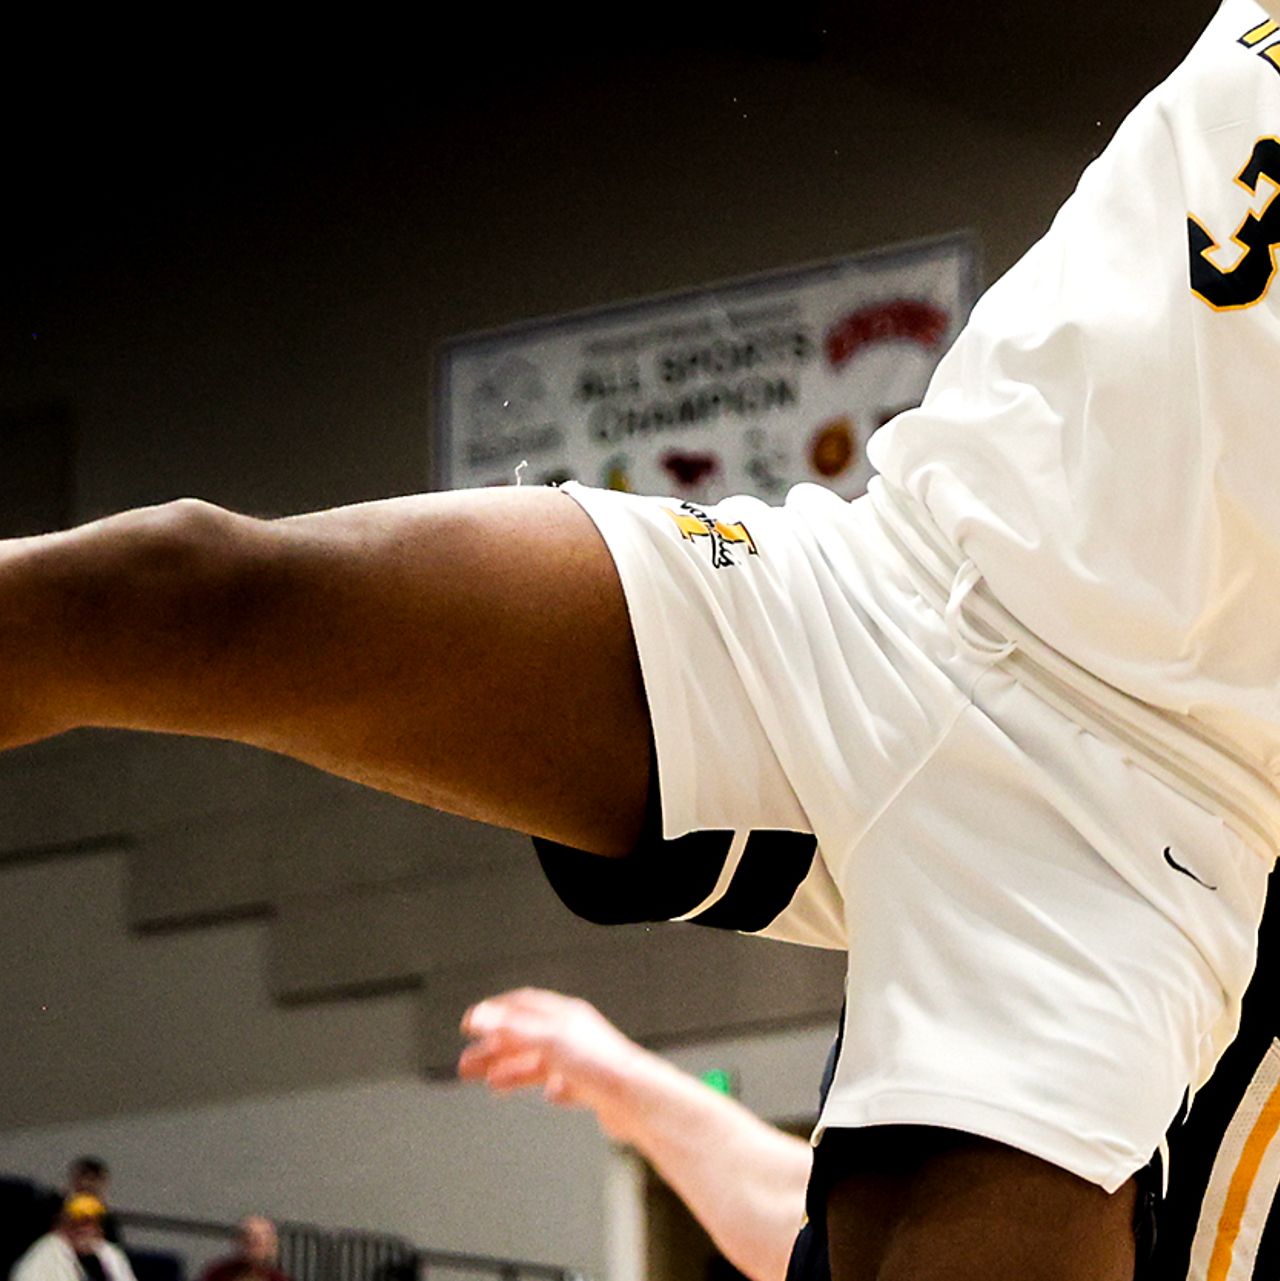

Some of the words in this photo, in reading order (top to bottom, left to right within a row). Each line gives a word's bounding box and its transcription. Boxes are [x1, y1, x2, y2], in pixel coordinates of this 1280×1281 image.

[576, 360, 641, 405] ALL
[658, 329, 812, 384] SPORTS
[589, 375, 797, 445] CHAMPION
